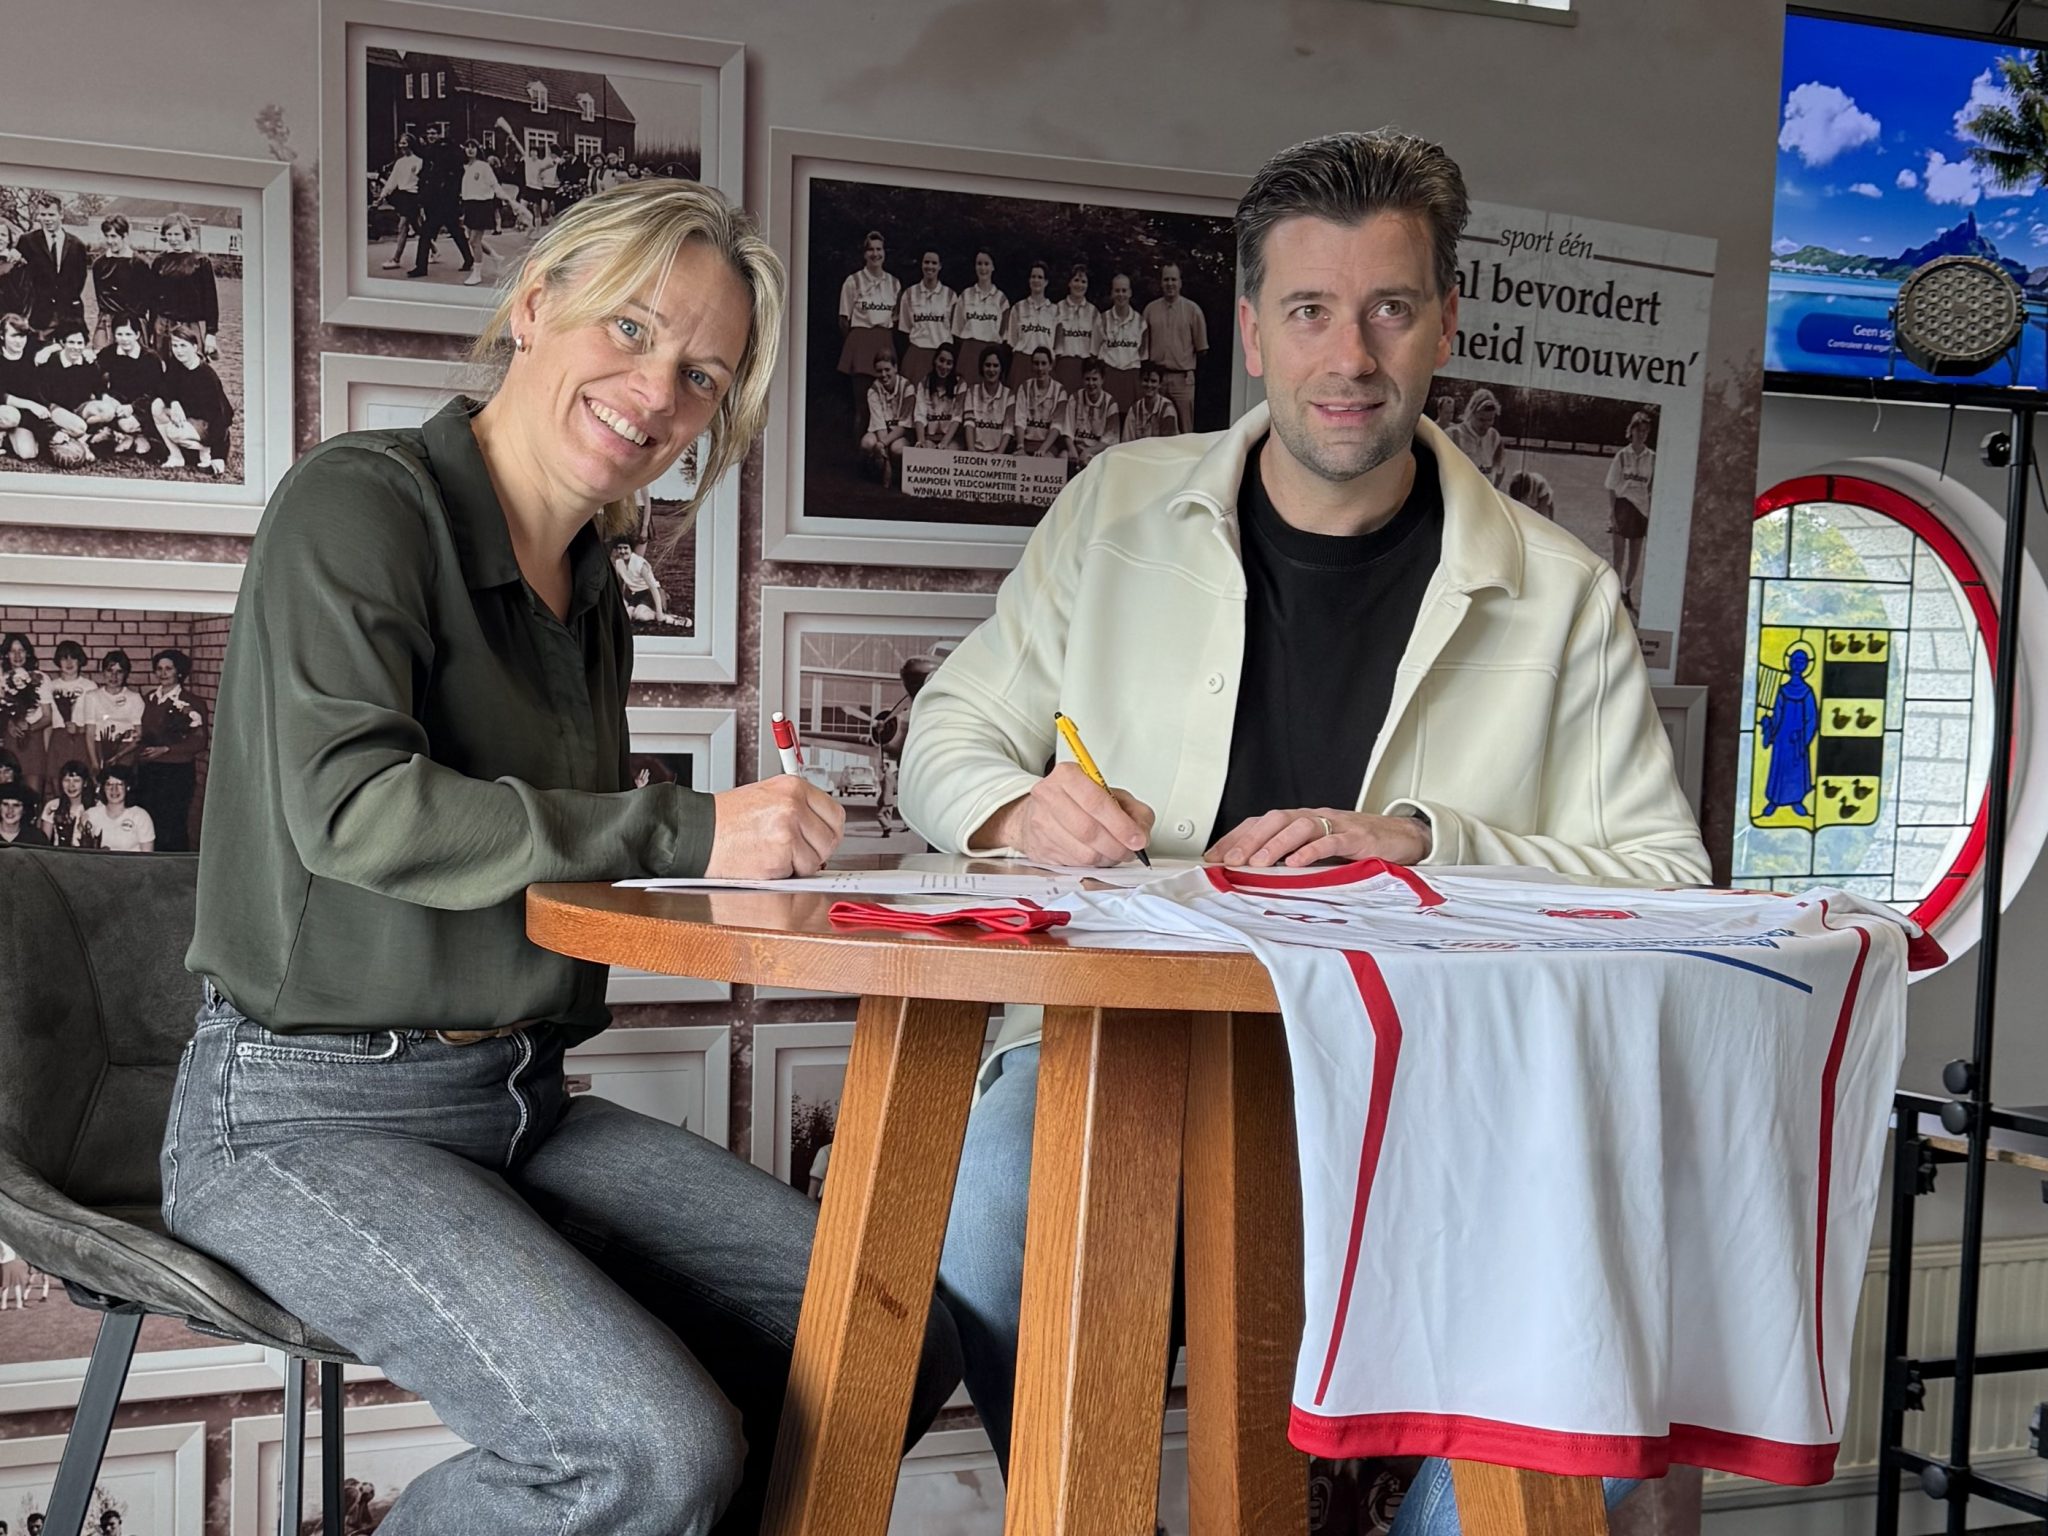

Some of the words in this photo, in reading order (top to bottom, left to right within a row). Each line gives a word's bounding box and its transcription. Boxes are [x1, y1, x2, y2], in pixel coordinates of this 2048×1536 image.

[1500, 228, 1555, 256] sport
[1559, 232, 1594, 260] één
[1491, 263, 1662, 326] bevordert
[1852, 324, 1878, 337] Geen
[1879, 327, 1893, 341] sig
[1534, 340, 1700, 387] vrouwen'
[953, 456, 988, 467] SEIZOEN
[990, 458, 1017, 469] 97/98
[906, 465, 950, 477] KAMPIOEN
[953, 468, 1018, 481] ZAALCOMPETITIE
[1034, 475, 1064, 485] KLASSE
[907, 476, 951, 488] KAMPIOEN
[953, 479, 1017, 492] VELDCOMPETITIE
[912, 487, 953, 498] WINNAAR
